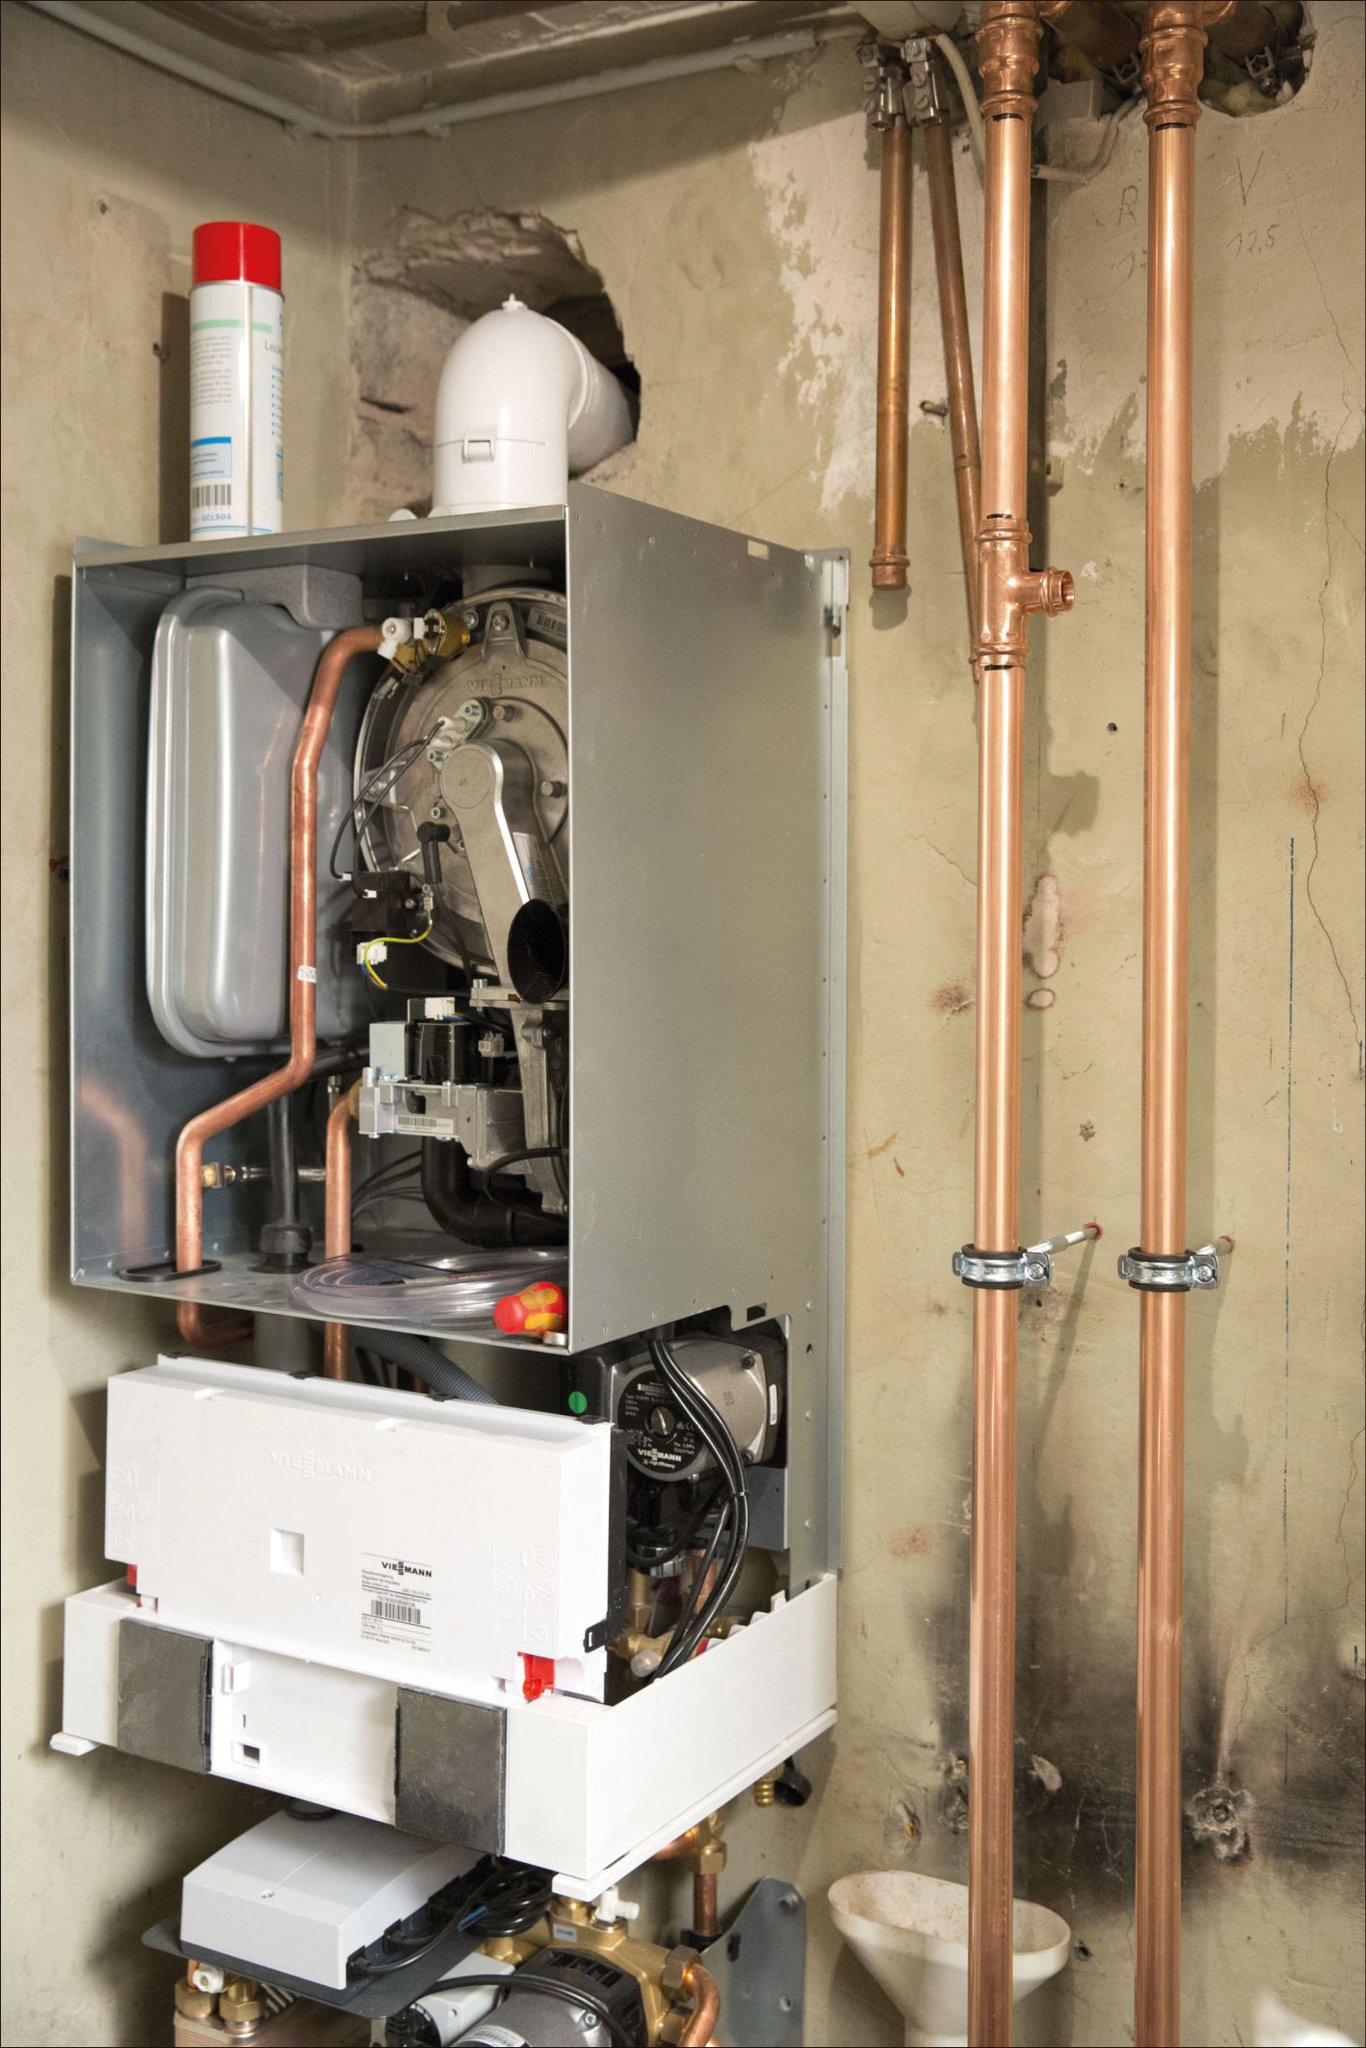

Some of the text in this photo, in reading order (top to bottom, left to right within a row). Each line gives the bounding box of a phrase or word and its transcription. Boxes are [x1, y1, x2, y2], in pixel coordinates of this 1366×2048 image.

[637, 1448, 682, 1462] VIESSMANN
[268, 1449, 371, 1482] VIESSMANN
[381, 1560, 433, 1578] VIESSMANN
